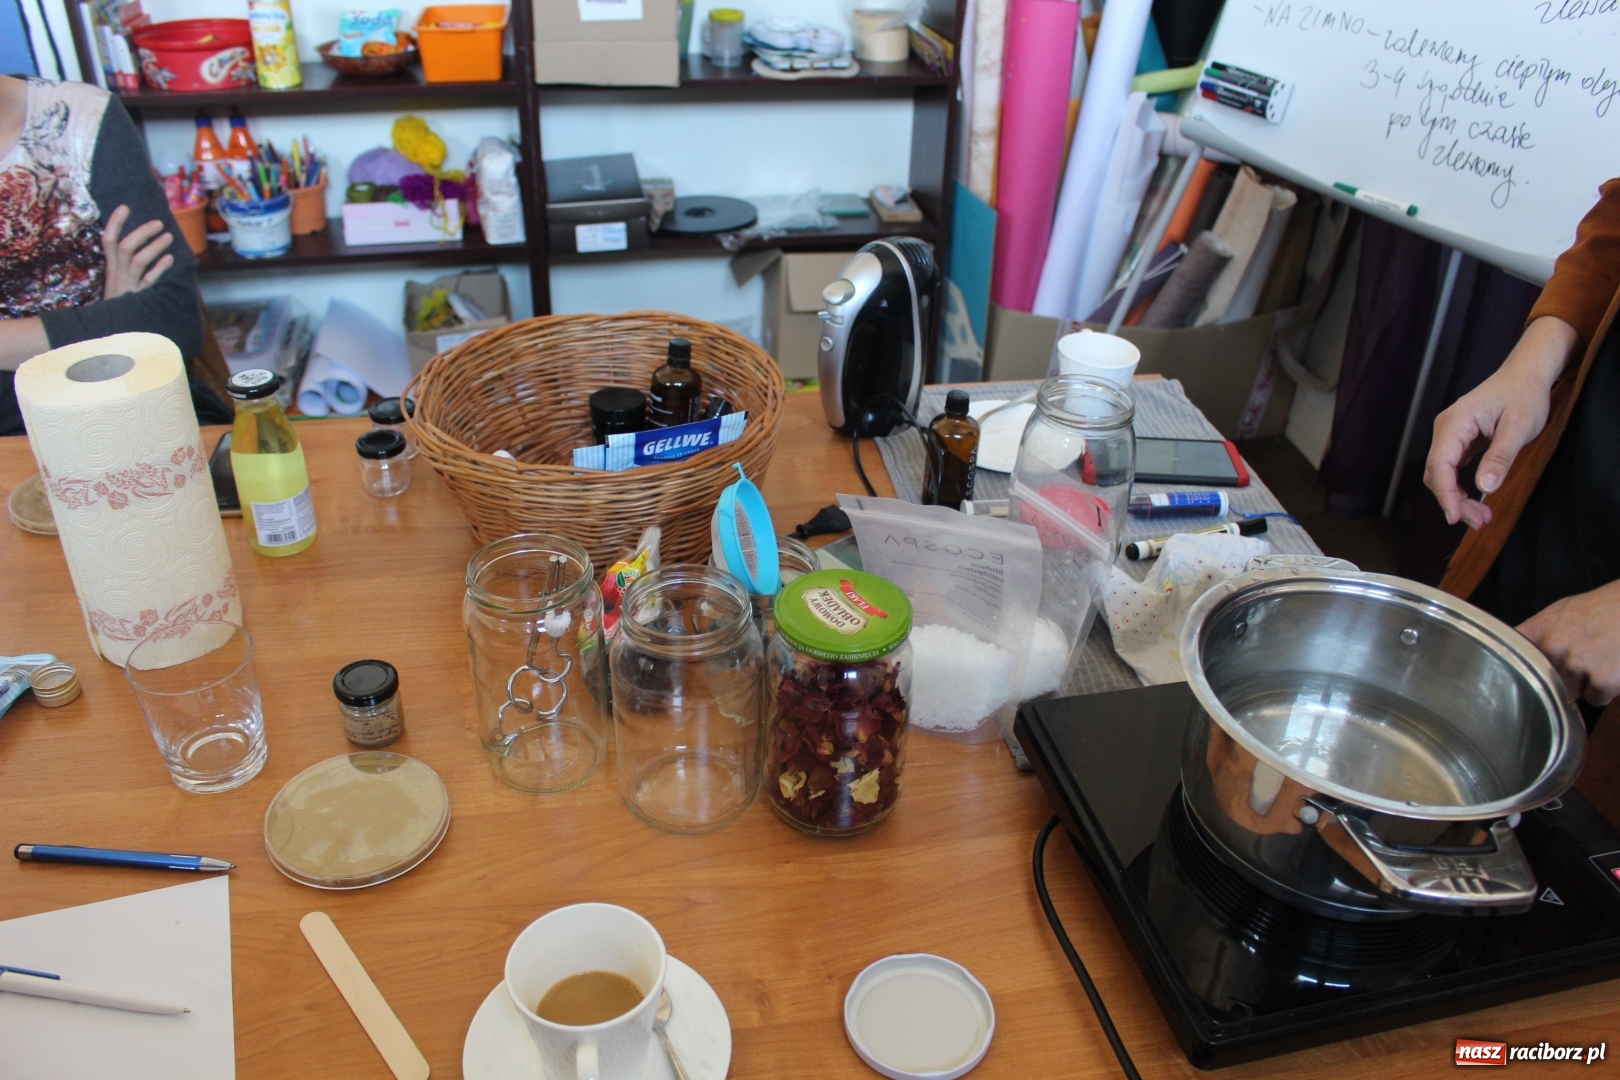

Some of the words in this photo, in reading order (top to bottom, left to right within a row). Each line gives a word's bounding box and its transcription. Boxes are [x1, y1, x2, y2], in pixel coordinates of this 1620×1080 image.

[643, 431, 713, 456] GELLWE
[965, 447, 977, 497] ECOSPA
[809, 598, 846, 628] DOMOWY
[818, 590, 861, 626] OBIADEK
[846, 591, 870, 610] FLAKI
[805, 646, 838, 659] DOBREGO
